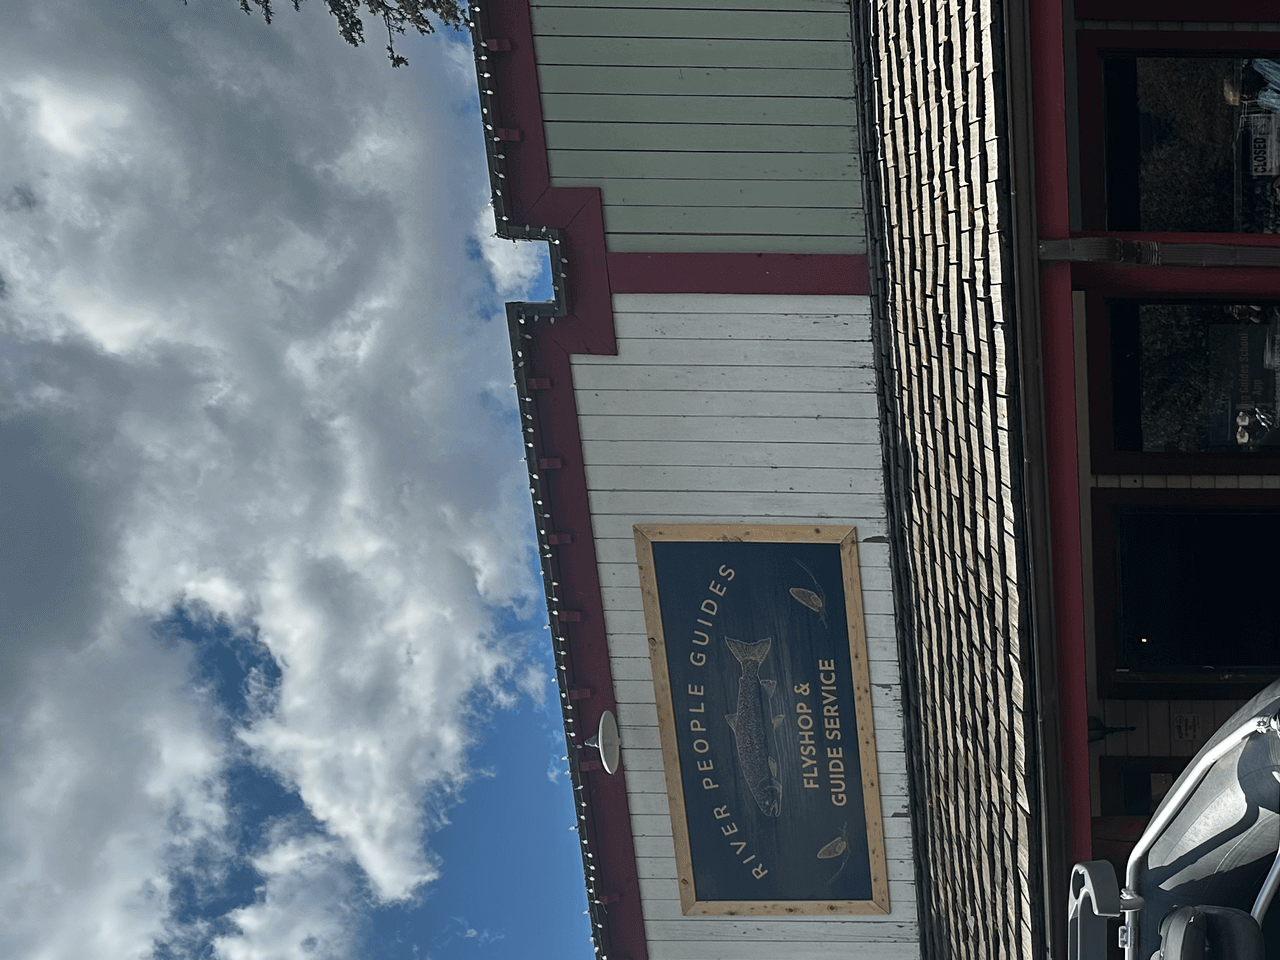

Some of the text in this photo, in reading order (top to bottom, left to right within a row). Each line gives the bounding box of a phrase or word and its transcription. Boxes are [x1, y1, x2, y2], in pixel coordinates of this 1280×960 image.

[1253, 138, 1266, 173] CLOSED
[1239, 333, 1249, 362] School
[1240, 364, 1249, 393] Guides
[1252, 379, 1262, 396] App
[688, 562, 768, 879] RIVER PEOPLE GUIDES
[794, 682, 819, 789] FLYSHOP &
[818, 658, 847, 807] GUIDE SERVICE
